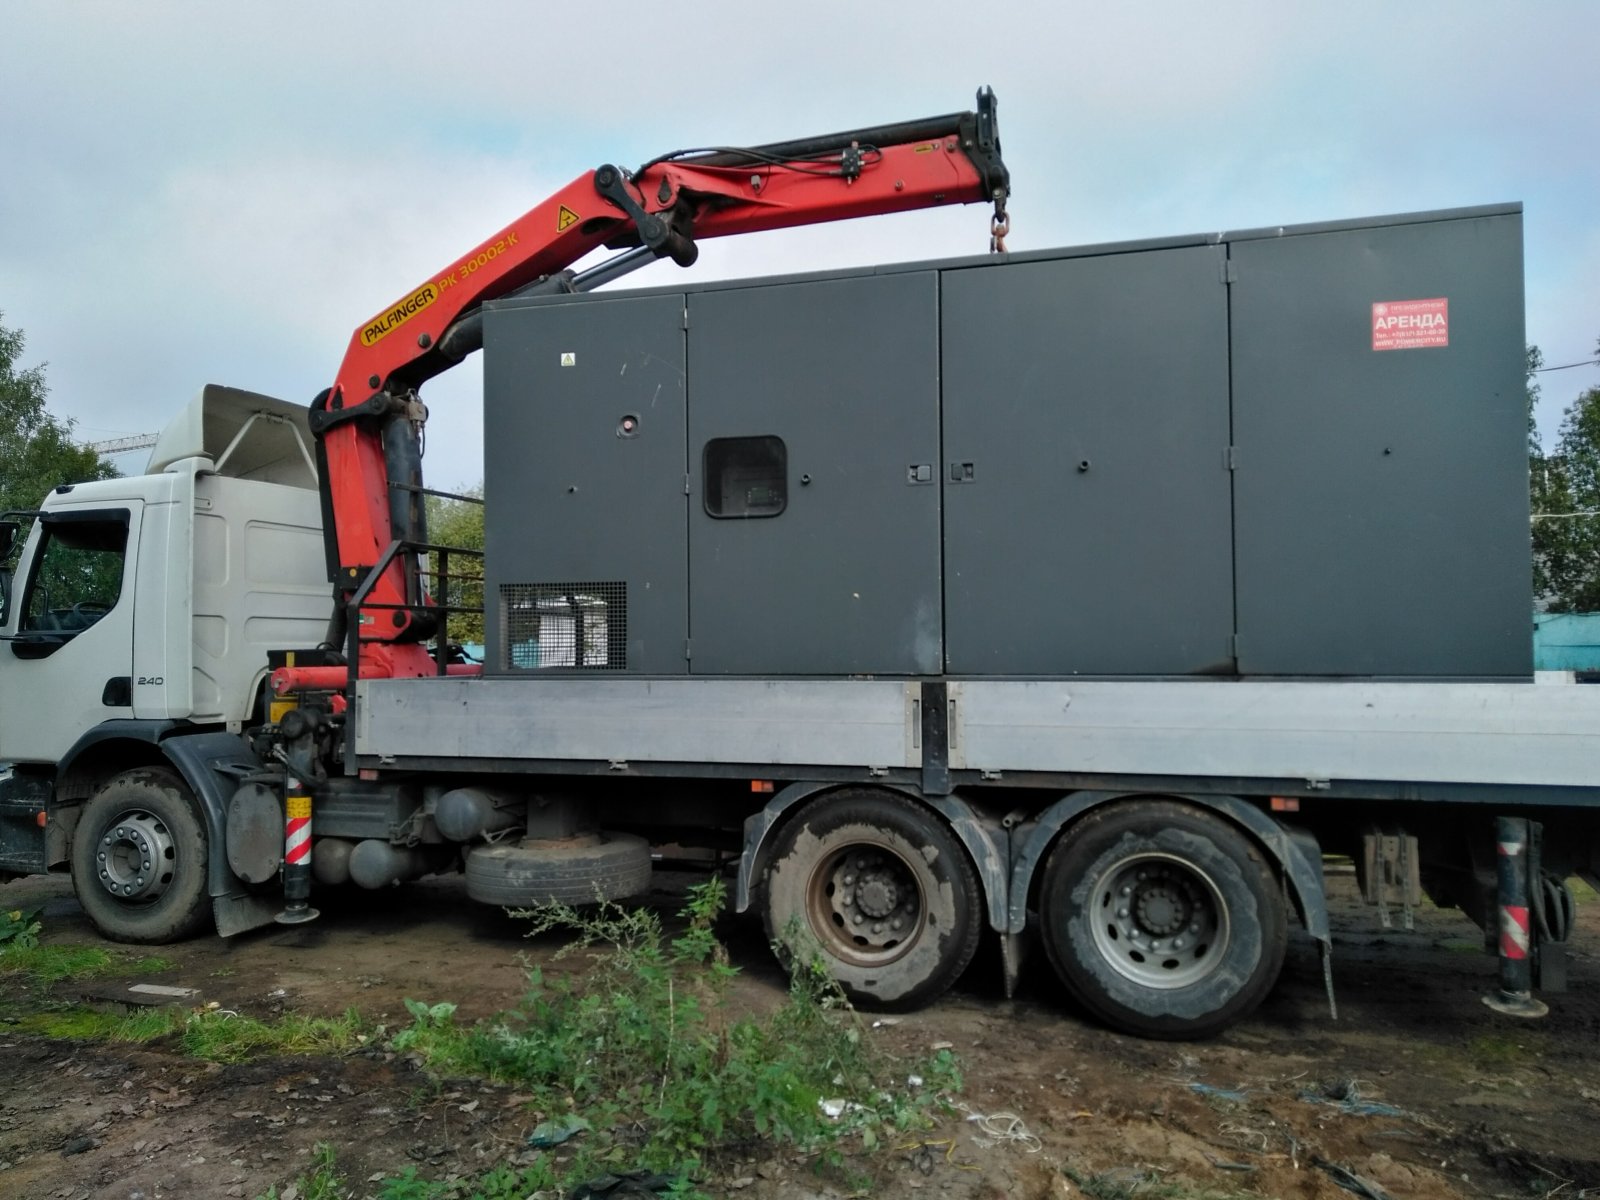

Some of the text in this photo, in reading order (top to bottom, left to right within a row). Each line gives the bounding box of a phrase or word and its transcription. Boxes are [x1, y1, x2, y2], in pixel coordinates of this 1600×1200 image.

[364, 231, 519, 343] PALFINGER PK 30002-K
[1375, 313, 1446, 330] АРЕНДА
[137, 676, 164, 686] 240
